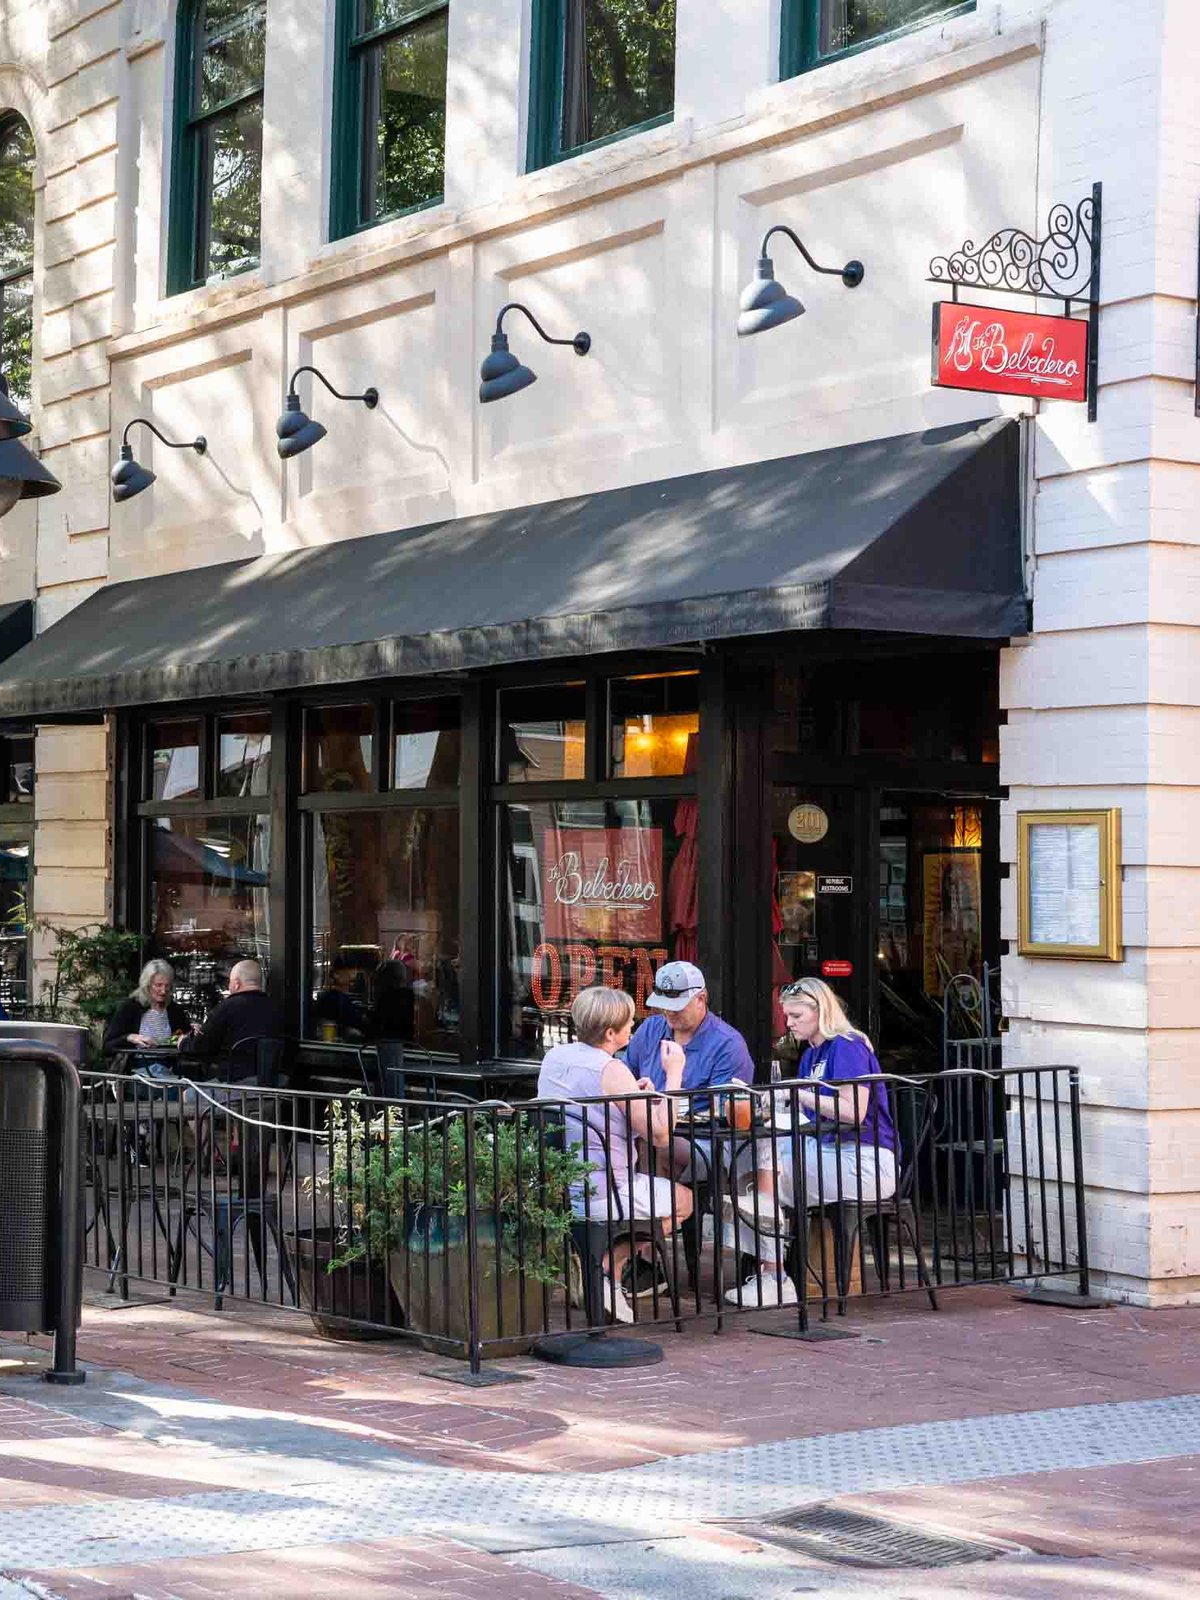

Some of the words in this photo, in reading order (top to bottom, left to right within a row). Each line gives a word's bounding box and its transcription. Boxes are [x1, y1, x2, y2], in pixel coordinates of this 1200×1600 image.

[980, 322, 1080, 378] Bebedero
[796, 811, 822, 830] 201
[554, 851, 660, 905] Bebedero
[531, 943, 669, 1016] OPEN
